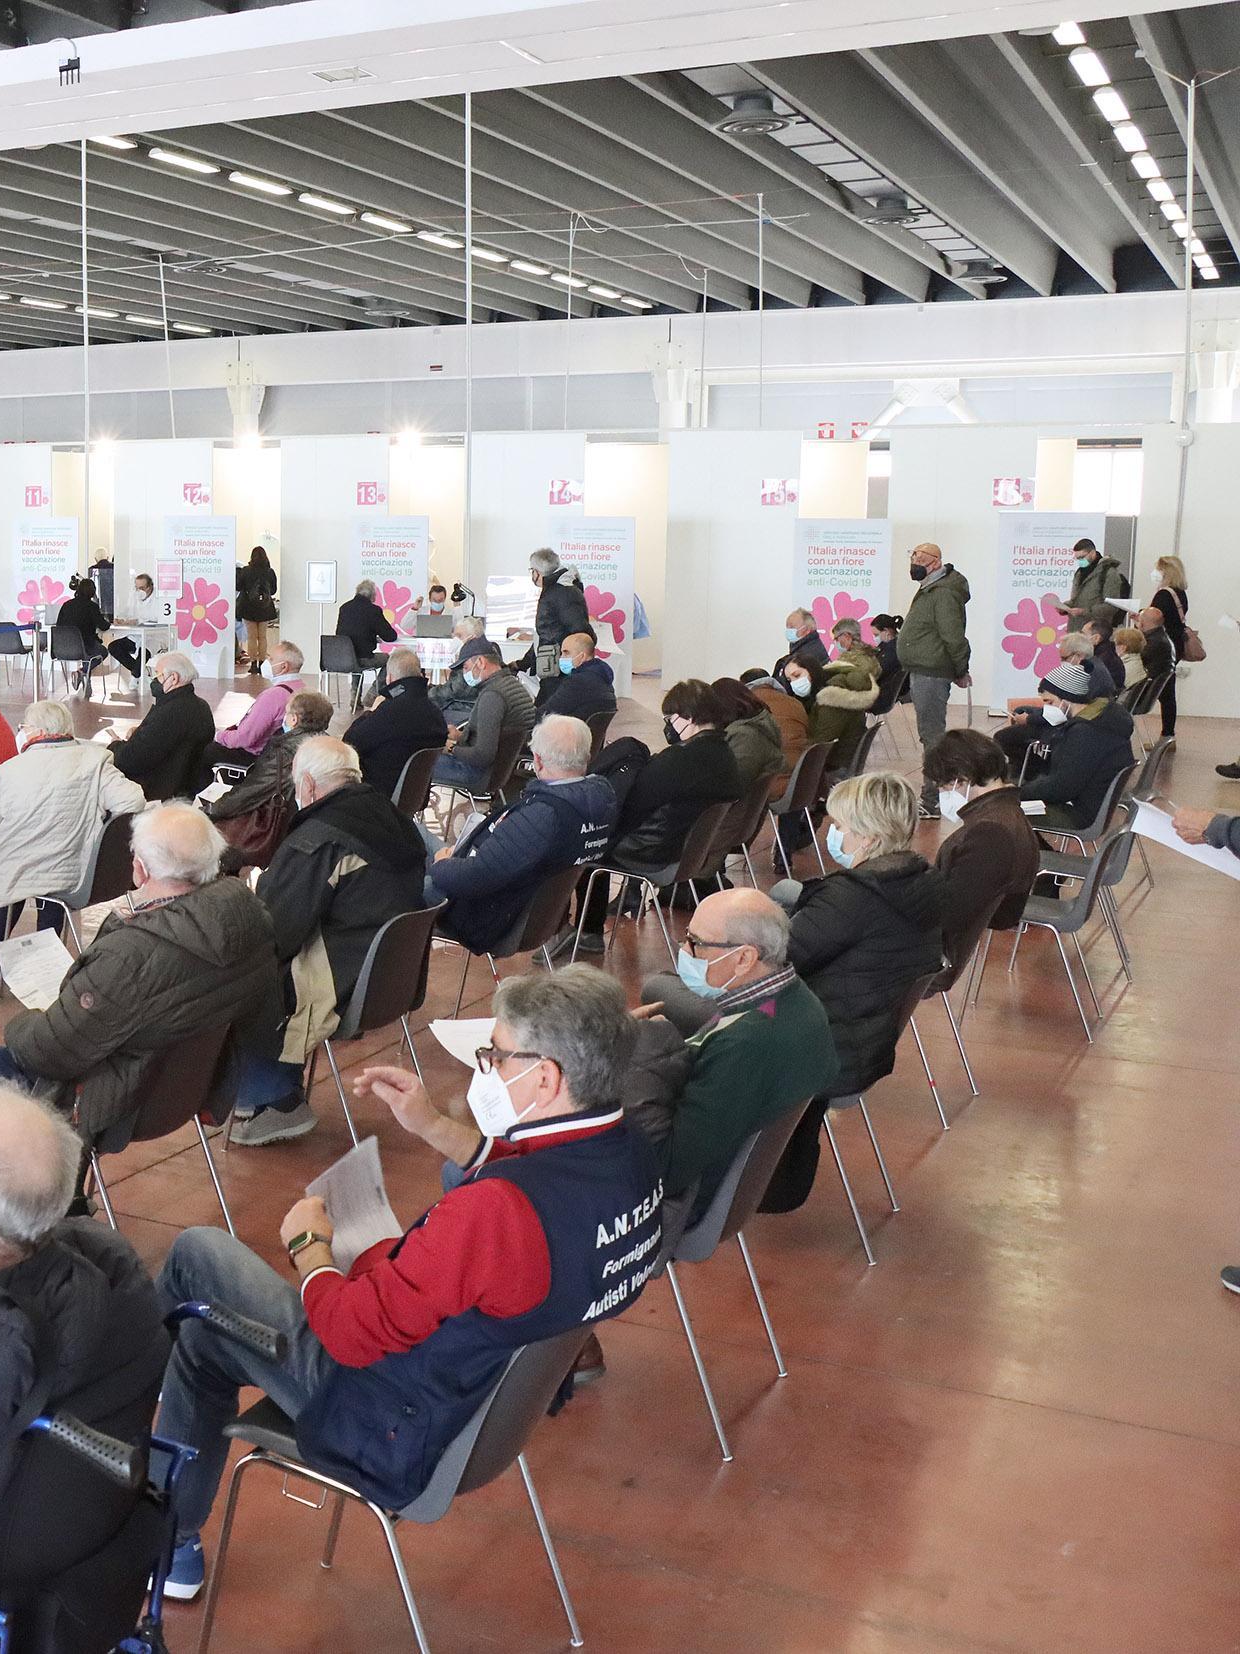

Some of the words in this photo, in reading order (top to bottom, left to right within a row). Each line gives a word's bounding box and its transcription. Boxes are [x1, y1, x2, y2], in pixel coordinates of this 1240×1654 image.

[27, 490, 40, 506] 11
[184, 487, 201, 503] 12
[358, 486, 376, 503] 13
[386, 541, 416, 549] rinasce
[588, 543, 621, 551] rinasce
[200, 548, 216, 556] fiore
[389, 550, 407, 558] fiore
[808, 546, 837, 555] l'Italia
[839, 547, 876, 556] rinasce
[1013, 546, 1044, 555] l'Italia
[1047, 546, 1074, 556] rinas
[591, 552, 611, 561] fiore
[1013, 558, 1032, 566] con
[1034, 558, 1047, 566] un
[1050, 556, 1074, 566] fiore
[842, 557, 864, 566] fiore
[362, 568, 402, 576] anti-Covid
[405, 568, 412, 576] 19
[808, 567, 872, 576] vaccinazione
[807, 577, 858, 586] anti-Covid
[862, 578, 871, 587] 19
[1012, 579, 1067, 588] anti-Covid
[163, 603, 171, 616] 3
[582, 1279, 628, 1322] Autisti
